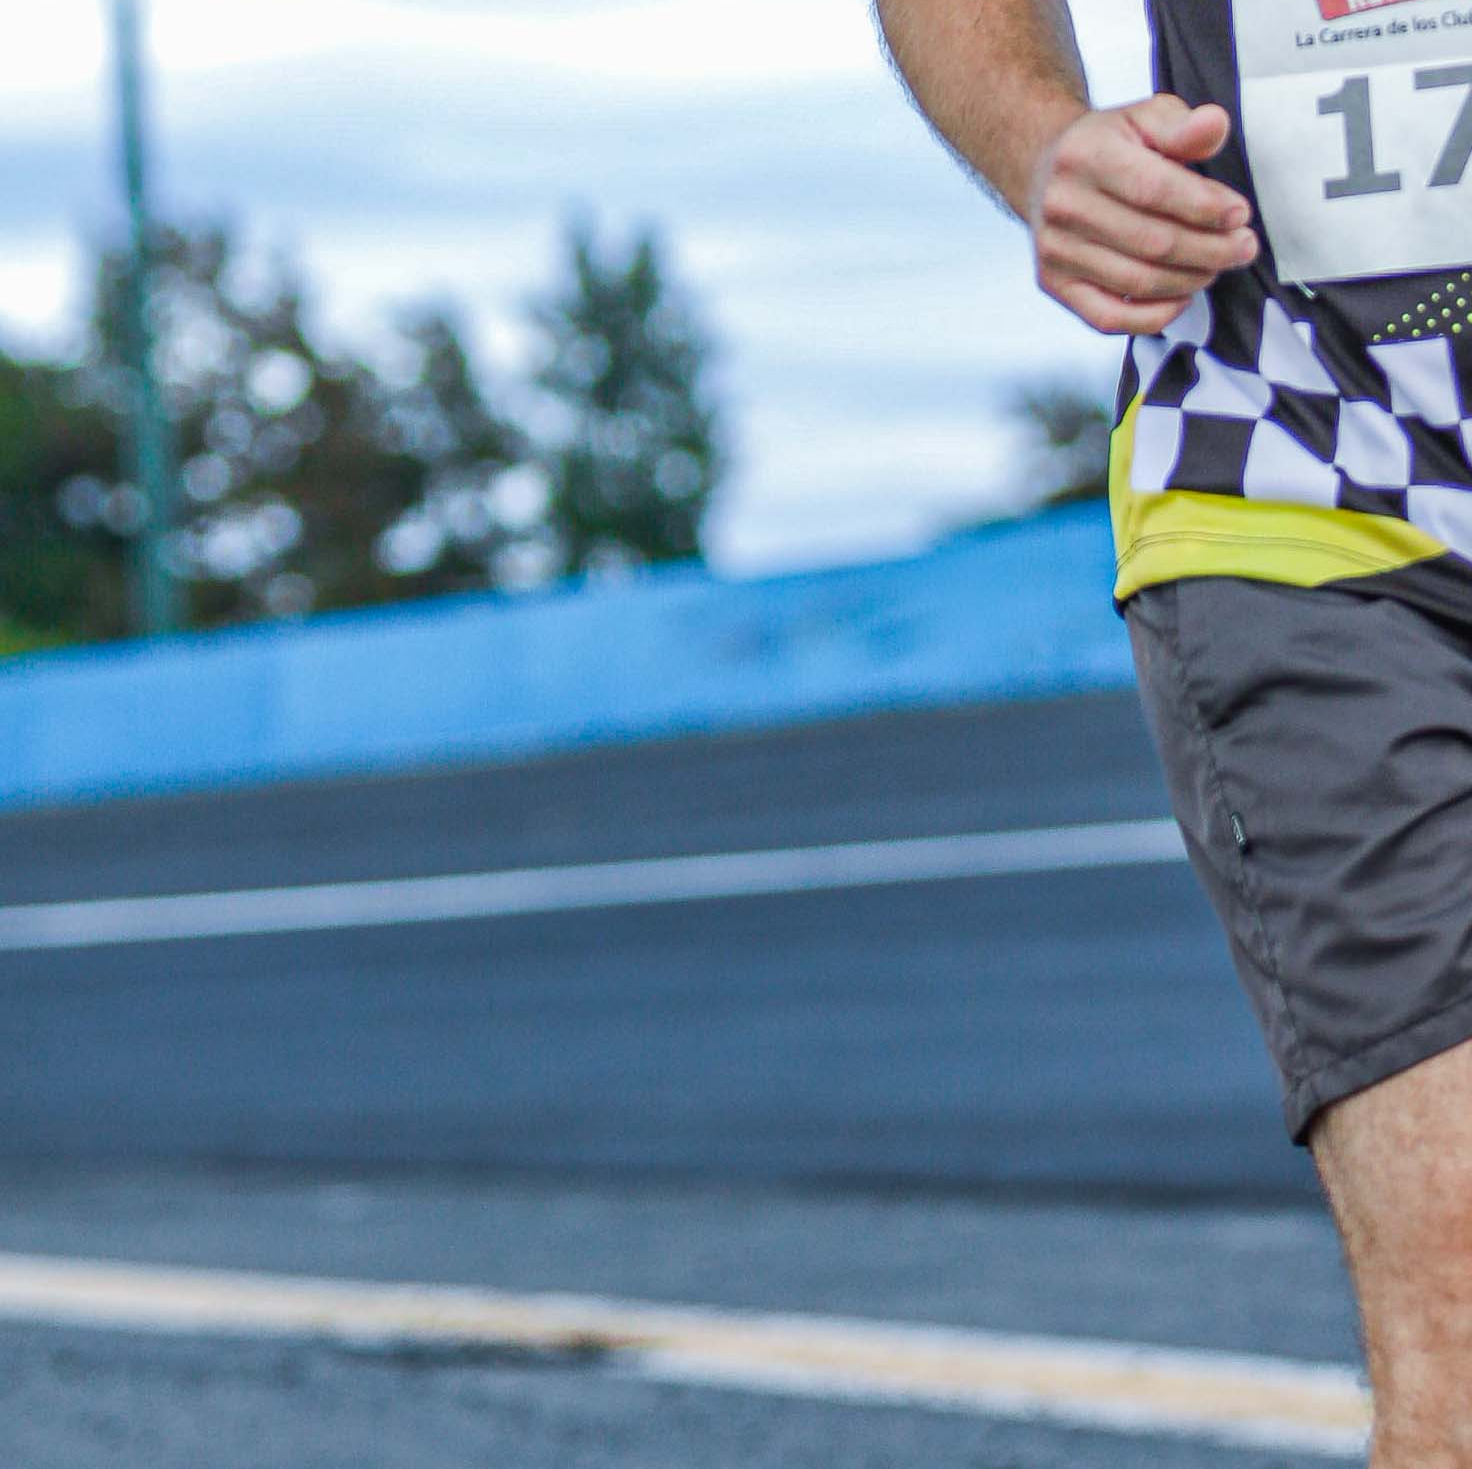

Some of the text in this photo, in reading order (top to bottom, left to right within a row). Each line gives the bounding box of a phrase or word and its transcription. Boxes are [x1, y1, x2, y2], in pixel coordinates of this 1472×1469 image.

[1295, 31, 1315, 47] La
[1319, 26, 1383, 44] Carrera
[1387, 20, 1408, 35] de
[1412, 16, 1437, 33] los
